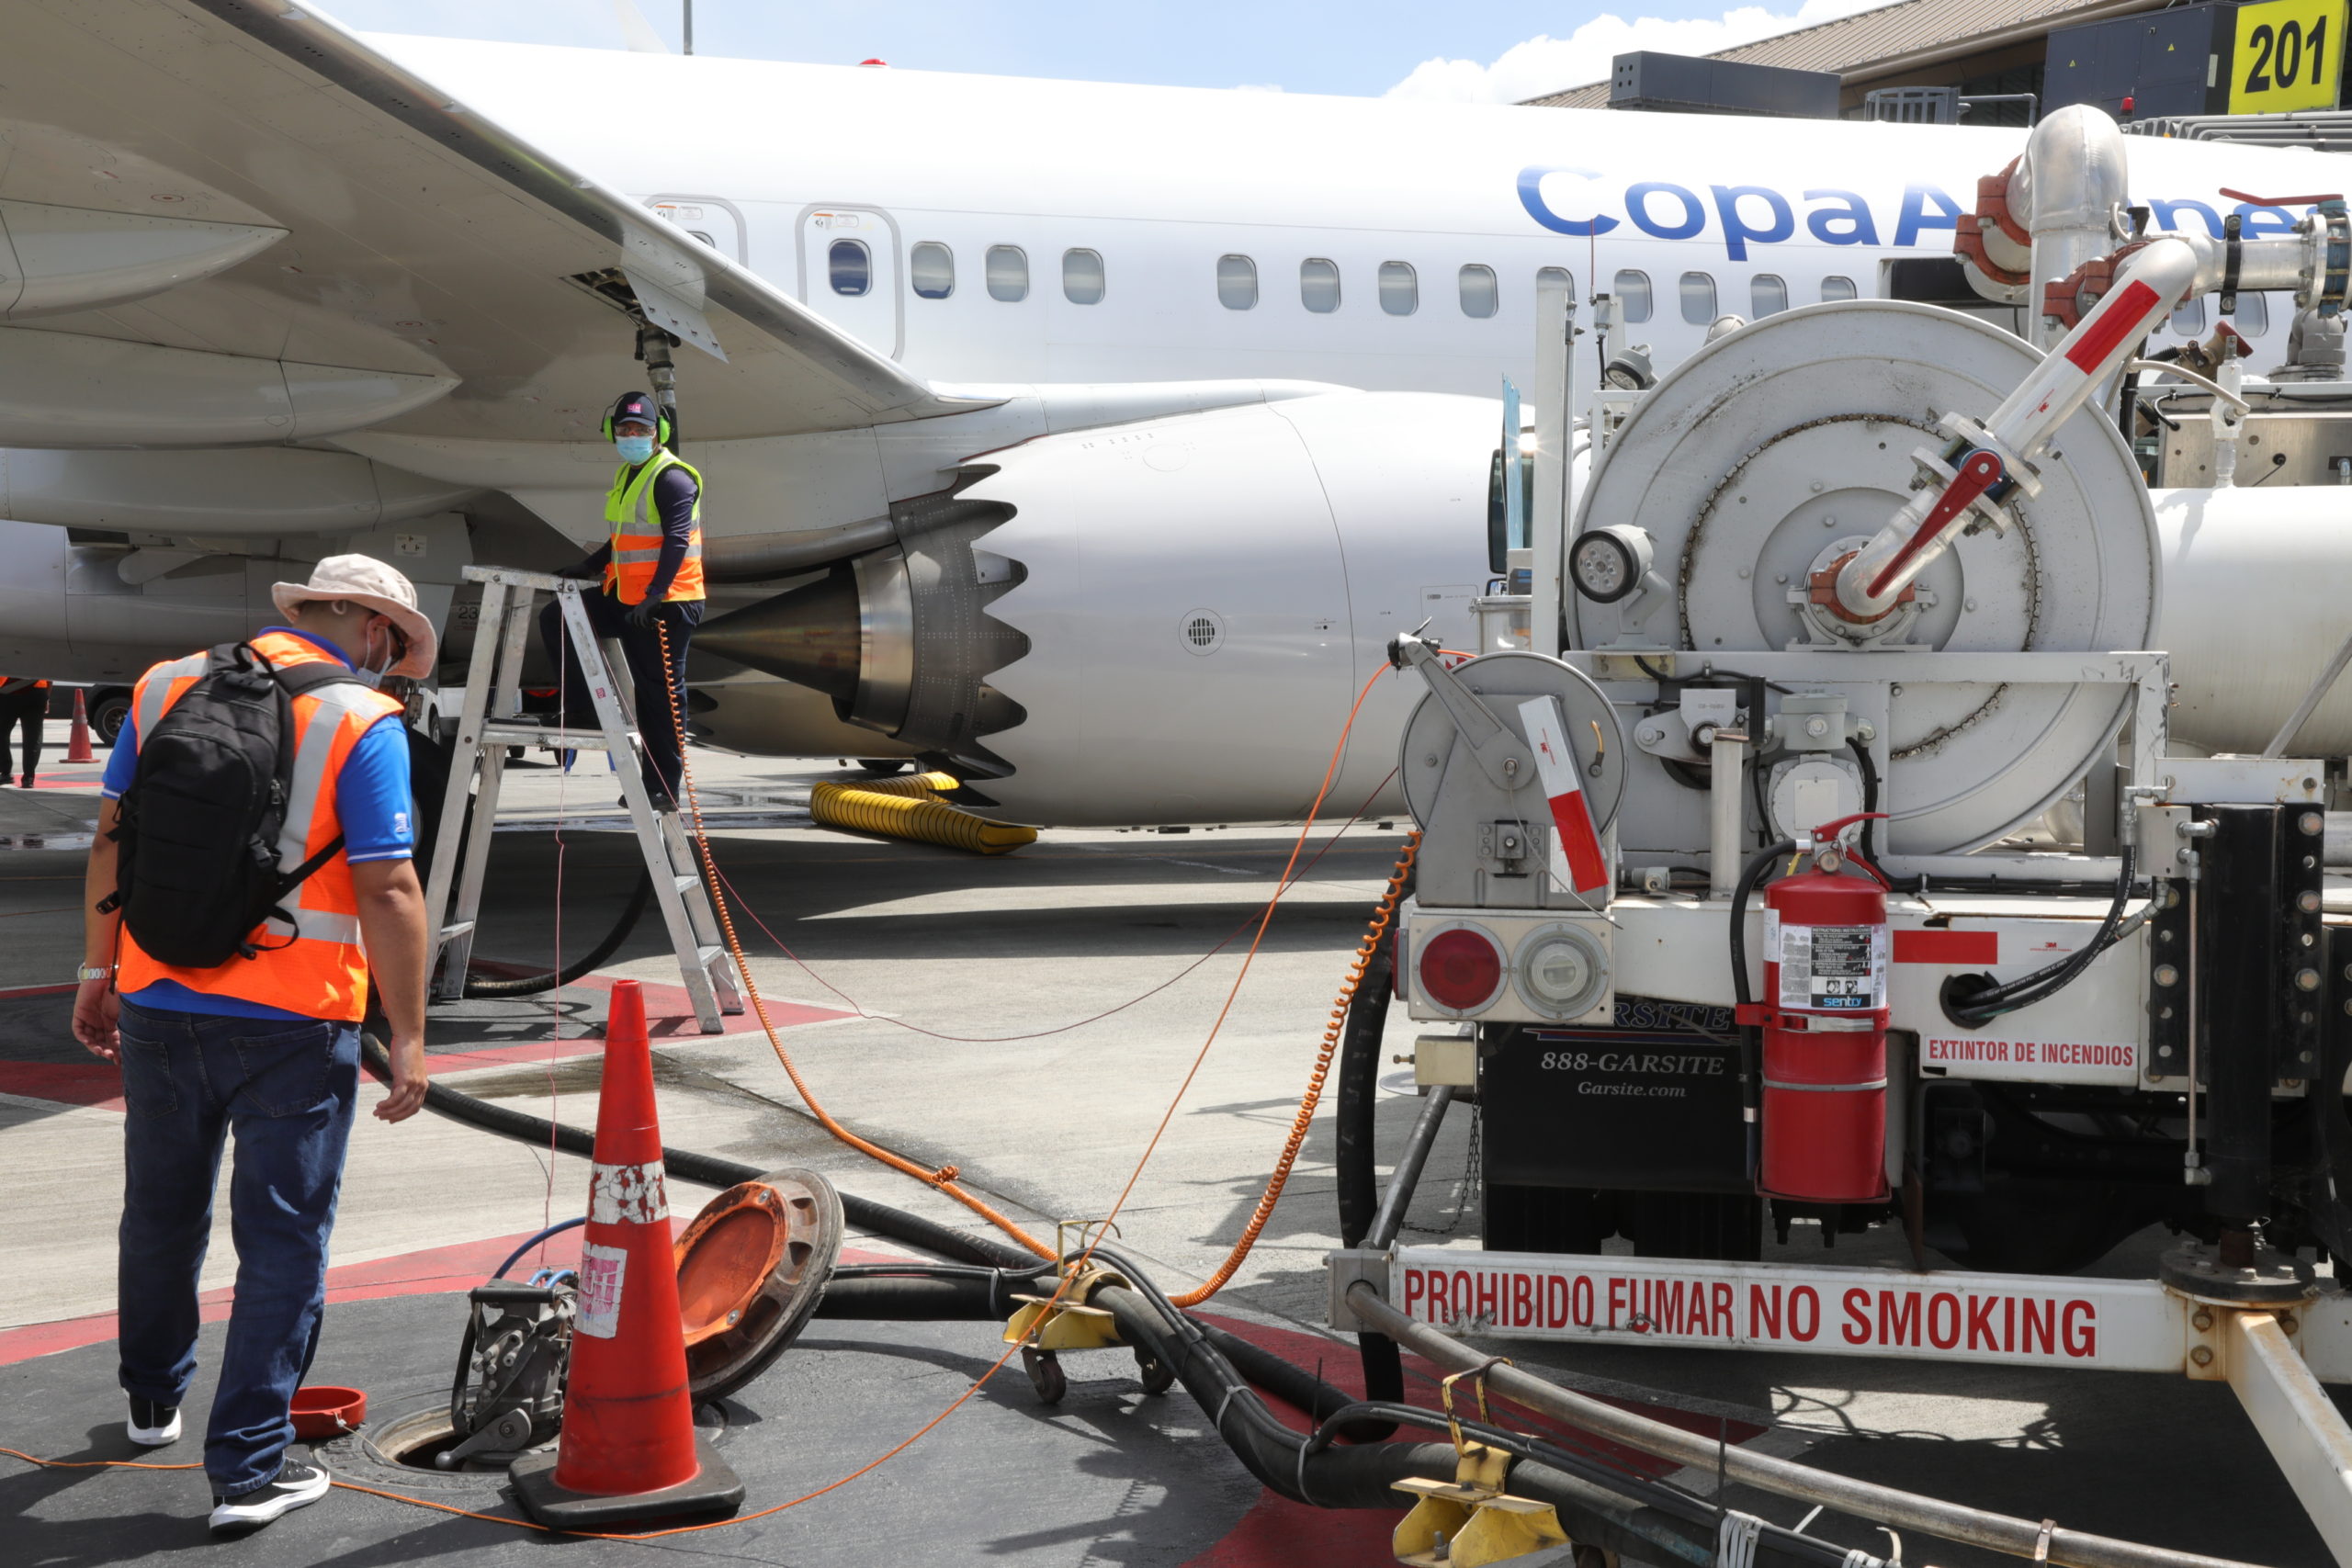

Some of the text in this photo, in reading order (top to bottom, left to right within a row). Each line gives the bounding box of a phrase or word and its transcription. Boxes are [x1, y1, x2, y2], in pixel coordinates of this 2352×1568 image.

[2245, 15, 2327, 94] 201
[1823, 996, 1862, 1007] sentry
[1614, 1002, 1731, 1030] RSITE
[1541, 1052, 1725, 1075] 888-GARSITE
[1929, 1039, 2133, 1066] EXTINTOR DE INCENDIOS
[1577, 1081, 1687, 1098] Garsite.com
[1405, 1269, 1735, 1337] PROHIBIDO FUMAR
[1749, 1284, 2096, 1357] NO SMOKING
